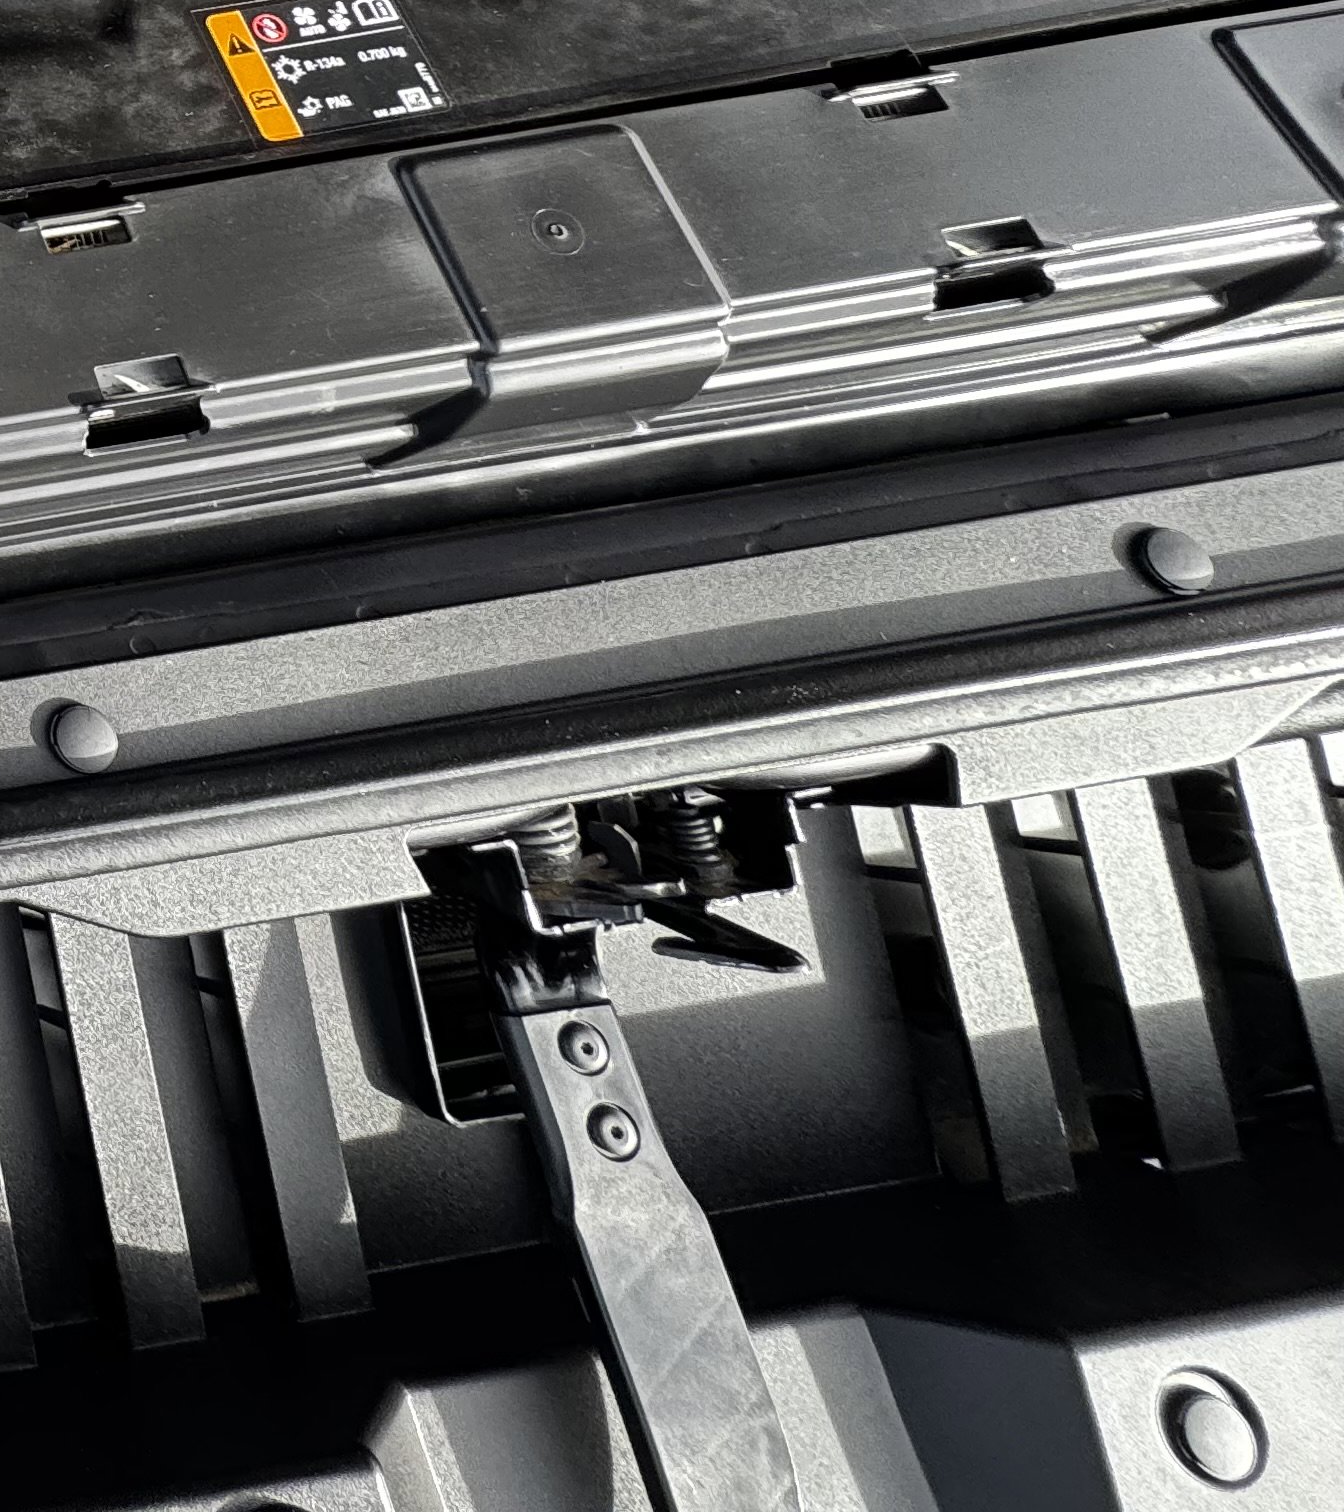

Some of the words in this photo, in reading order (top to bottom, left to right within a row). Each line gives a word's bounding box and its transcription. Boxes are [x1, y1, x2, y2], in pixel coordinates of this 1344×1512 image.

[299, 24, 327, 37] AUTO
[303, 56, 347, 72] R-134a
[357, 47, 389, 62] 0.700
[389, 46, 408, 58] kg
[325, 94, 354, 110] PAG
